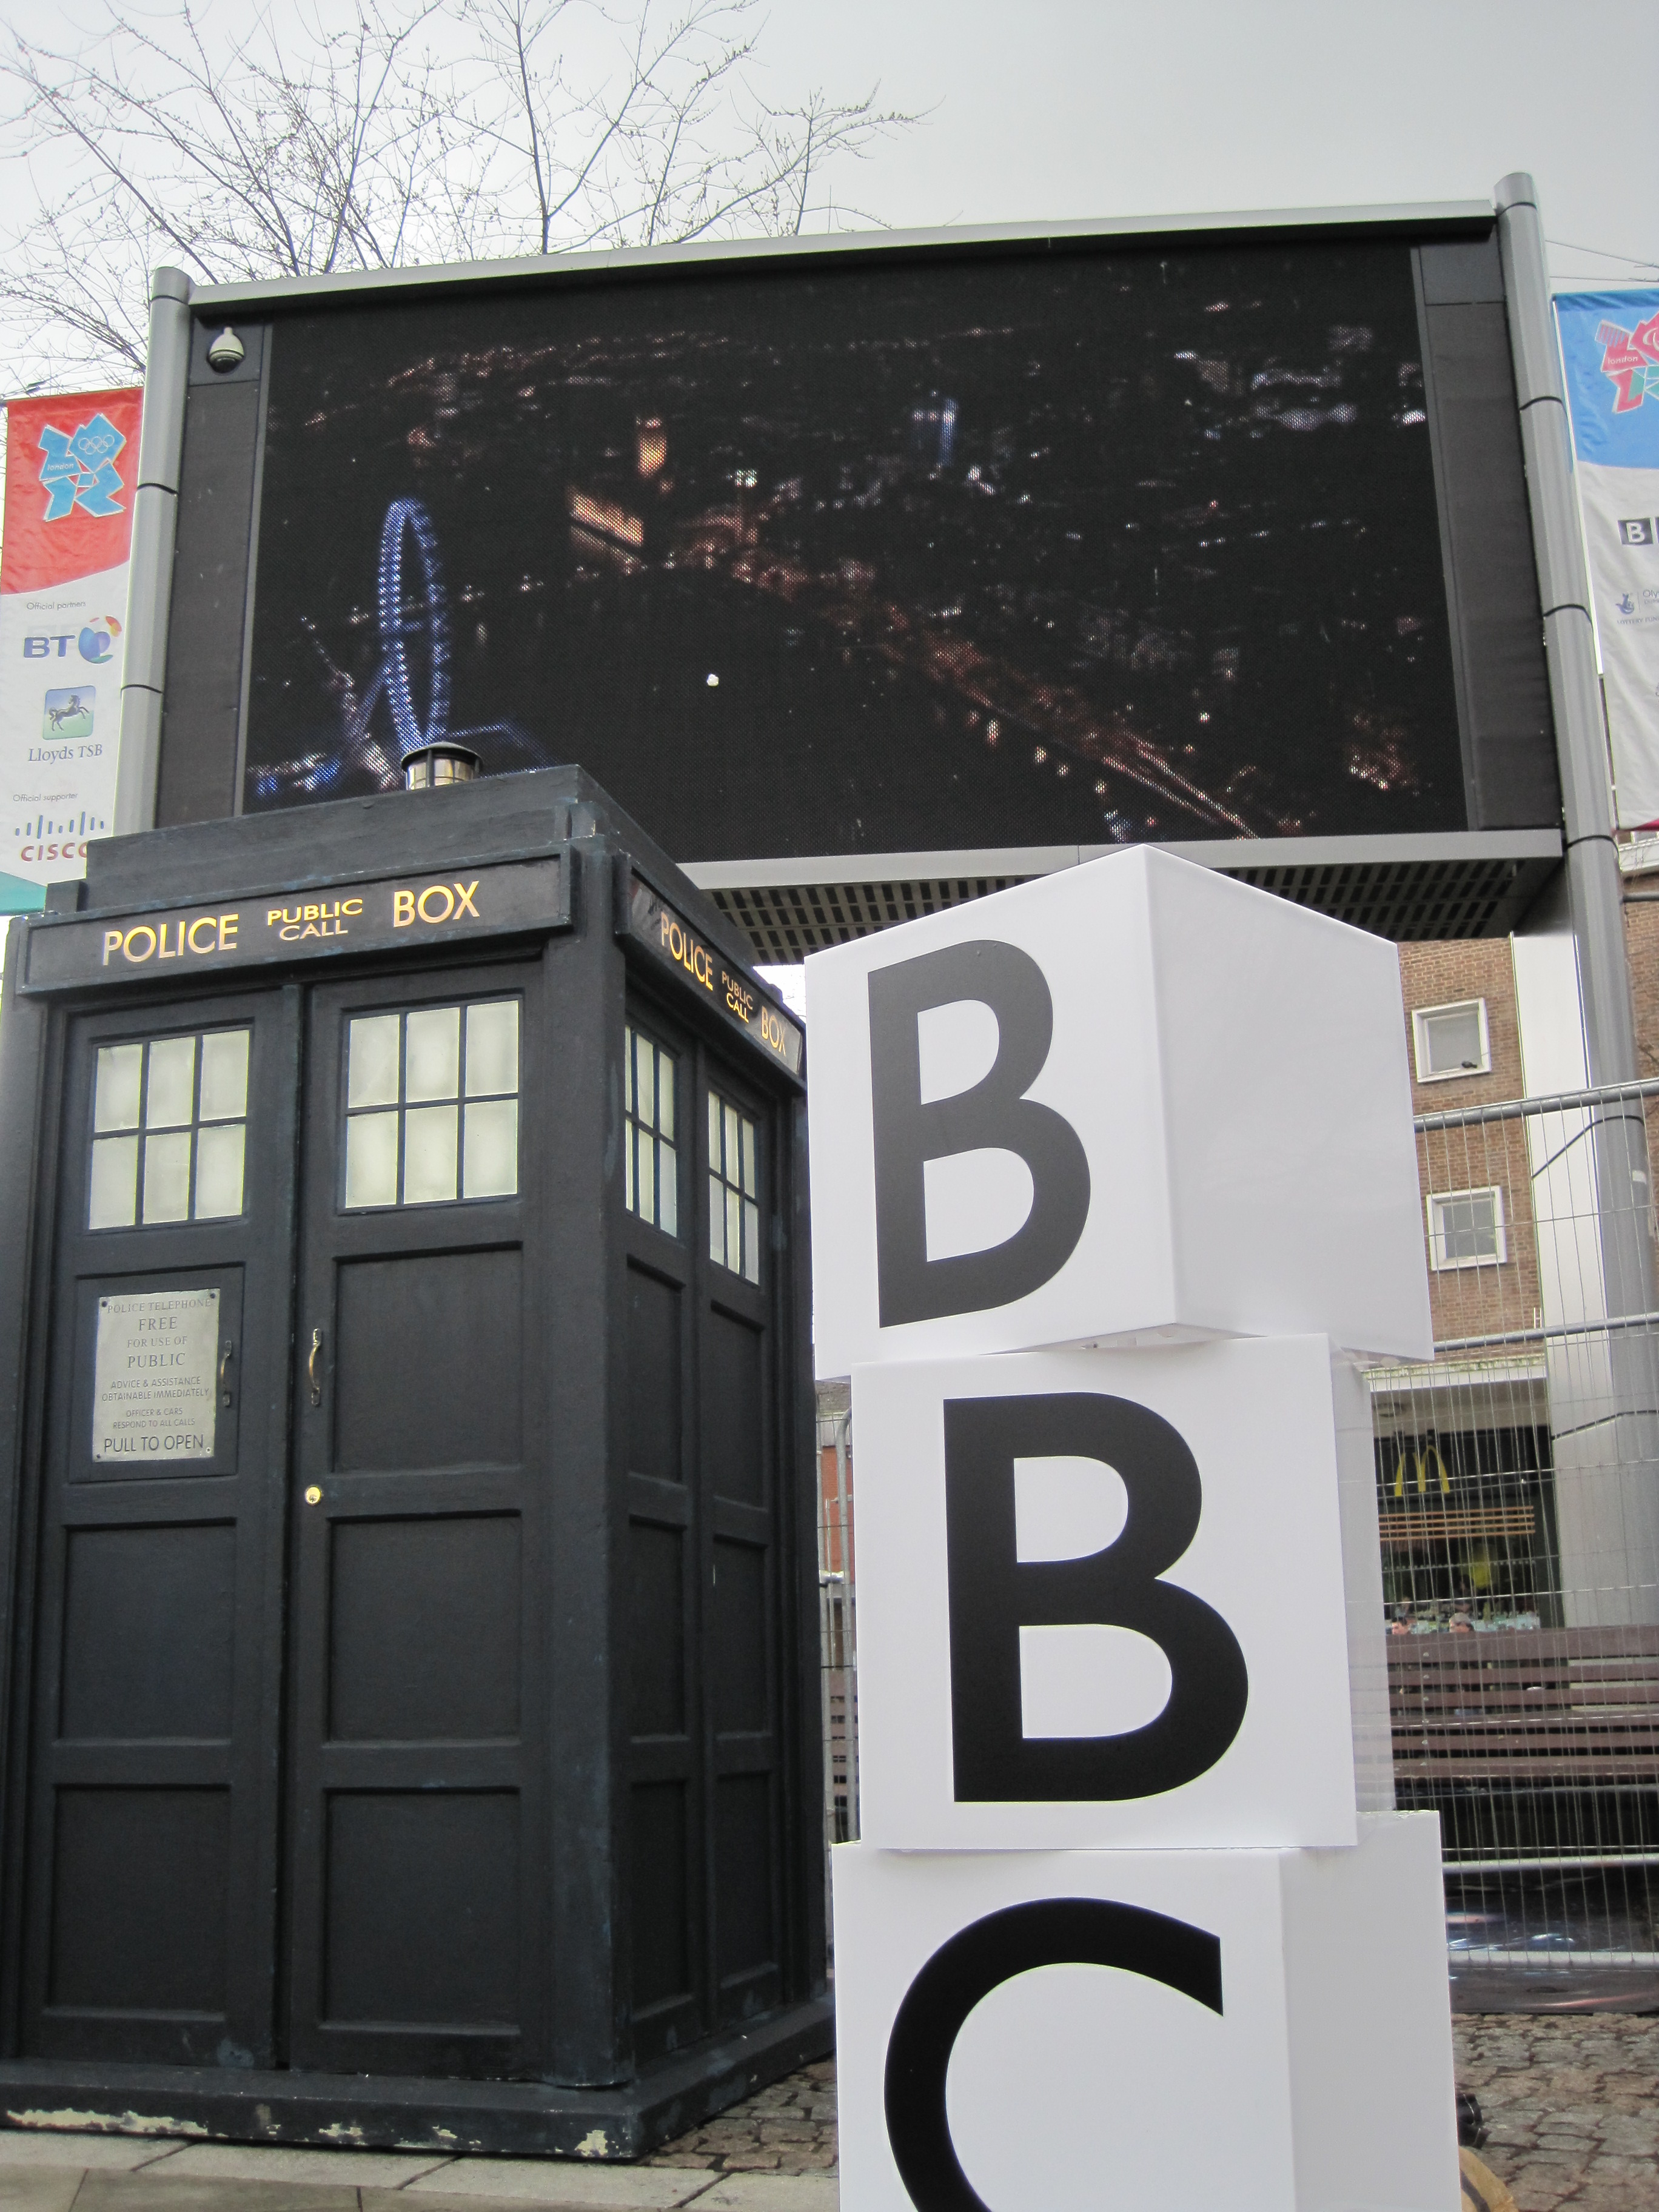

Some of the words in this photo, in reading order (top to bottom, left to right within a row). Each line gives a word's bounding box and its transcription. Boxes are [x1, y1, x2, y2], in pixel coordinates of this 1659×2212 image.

[1608, 355, 1638, 364] london
[47, 463, 74, 471] london
[27, 602, 55, 610] Official
[57, 601, 86, 611] partners
[24, 635, 76, 658] BT
[27, 746, 74, 765] Lloyds
[78, 743, 102, 758] TSB
[13, 793, 41, 802] Official
[43, 793, 78, 803] supporter
[392, 880, 480, 927] BOX
[267, 897, 363, 927] PUBLIC
[279, 919, 348, 941] CALL
[102, 913, 239, 965] POLICE
[661, 911, 713, 991] POLICE
[722, 971, 753, 1010] PUBLIC
[726, 992, 749, 1024] CALL
[762, 1005, 786, 1057] BOX
[107, 1302, 145, 1314] POLICE
[148, 1298, 211, 1311] TELEPHONE
[138, 1316, 178, 1331] FREE
[127, 1338, 147, 1348] FOR
[151, 1337, 170, 1347] USE
[174, 1336, 188, 1346] OF
[128, 1352, 186, 1368] PUBLIC
[111, 1379, 141, 1389] ADVICE
[143, 1379, 149, 1387] &
[152, 1376, 201, 1387] ASSISTANCE
[102, 1391, 152, 1401] OBTAINABLE
[154, 1387, 209, 1398] IMMEDIATELY
[126, 1409, 154, 1417] OFFICER
[113, 1420, 147, 1429] RESPOND
[174, 1418, 195, 1426] CALLS
[104, 1437, 136, 1453] PULL
[141, 1435, 159, 1451] TO
[164, 1433, 204, 1450] OPEN
